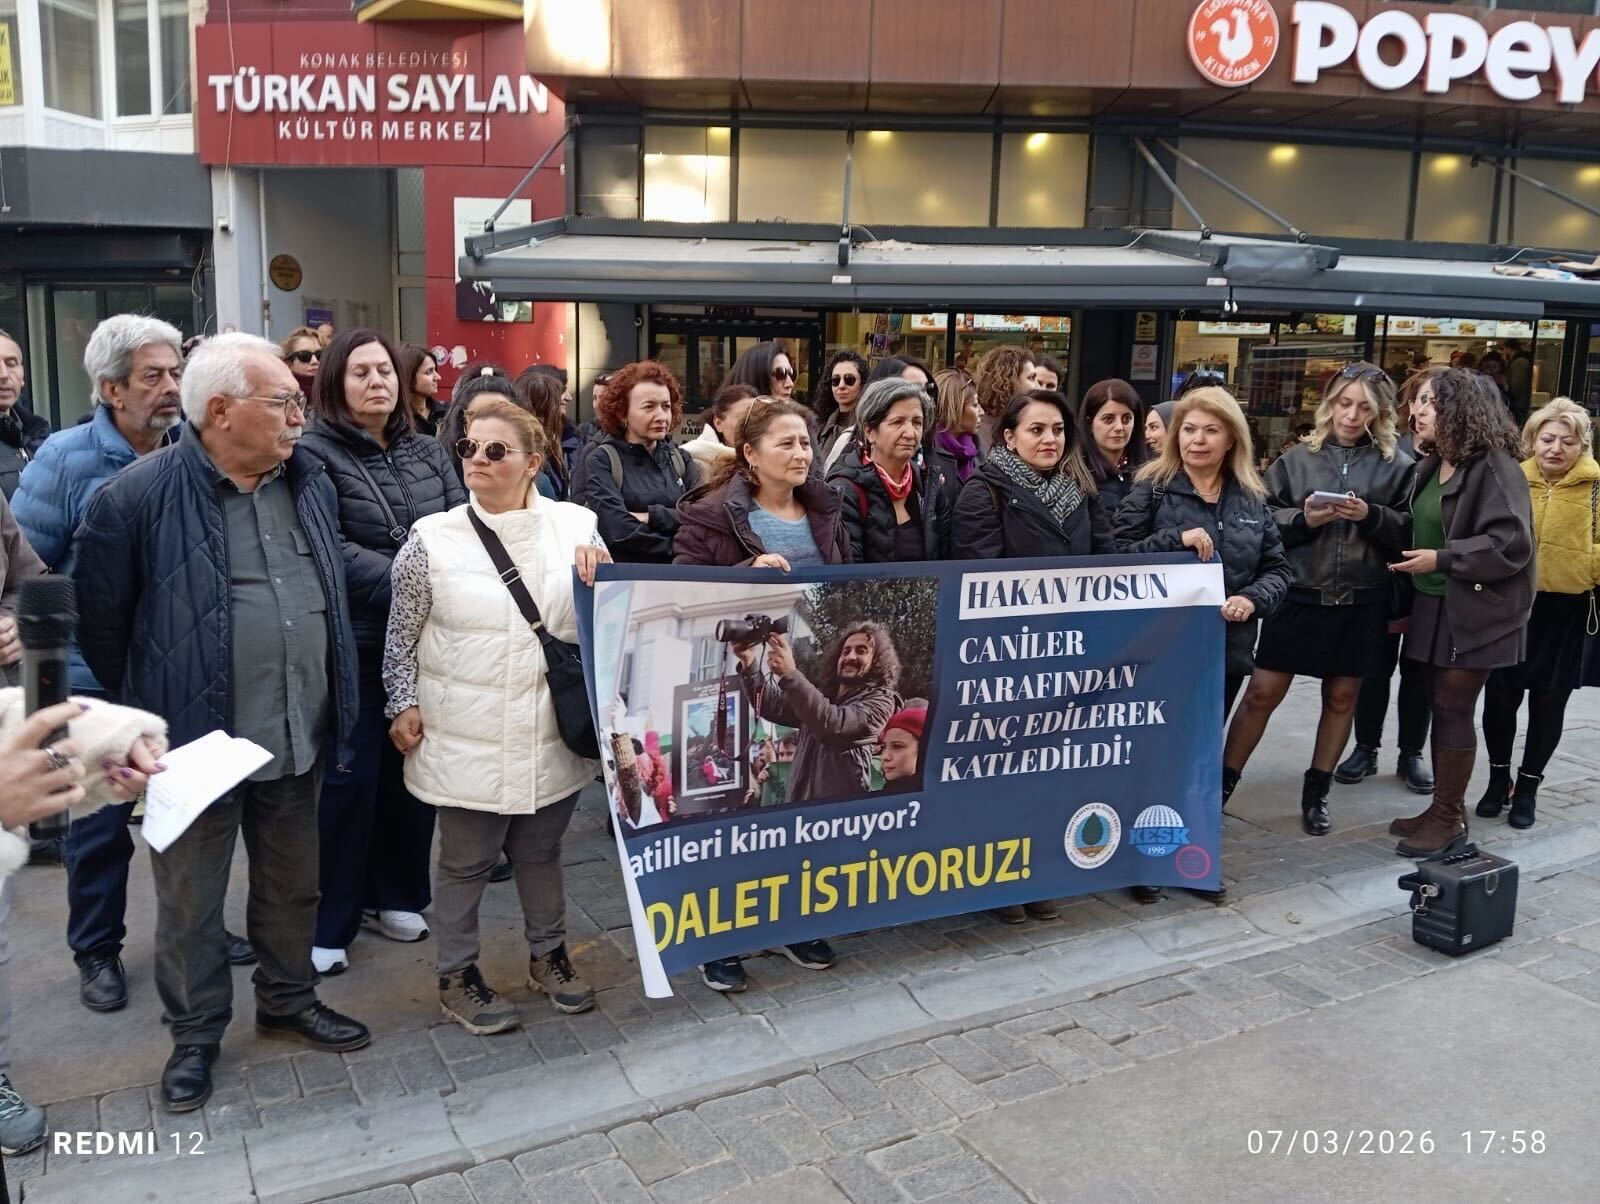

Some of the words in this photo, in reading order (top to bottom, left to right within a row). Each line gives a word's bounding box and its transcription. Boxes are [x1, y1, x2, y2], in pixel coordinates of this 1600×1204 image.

[300, 52, 360, 69] KONAK
[365, 50, 469, 69] BELEDİYESİ
[1204, 56, 1261, 80] KITCHEN
[208, 66, 376, 113] TÜRKAN
[387, 74, 549, 113] SAYLAN
[279, 117, 374, 140] KÜLTÜR
[382, 118, 492, 142] MERKEZİ
[967, 576, 1070, 609] HAKAN
[1075, 572, 1169, 602] TOSUN
[959, 625, 1086, 665] CANİLER
[956, 664, 1138, 706] TARAFINDAN
[945, 711, 1020, 747] LİNÇ
[1022, 700, 1168, 738] EDİLEREK
[939, 734, 1132, 783] KATLEDİLDİ!
[629, 828, 722, 879] atilleri
[730, 823, 787, 856] kim
[795, 800, 921, 844] koruyor?
[1127, 826, 1191, 846] KESK
[1148, 846, 1166, 855] 1995
[646, 874, 789, 954] DALET
[800, 836, 1031, 917] İSTİYORUZ!
